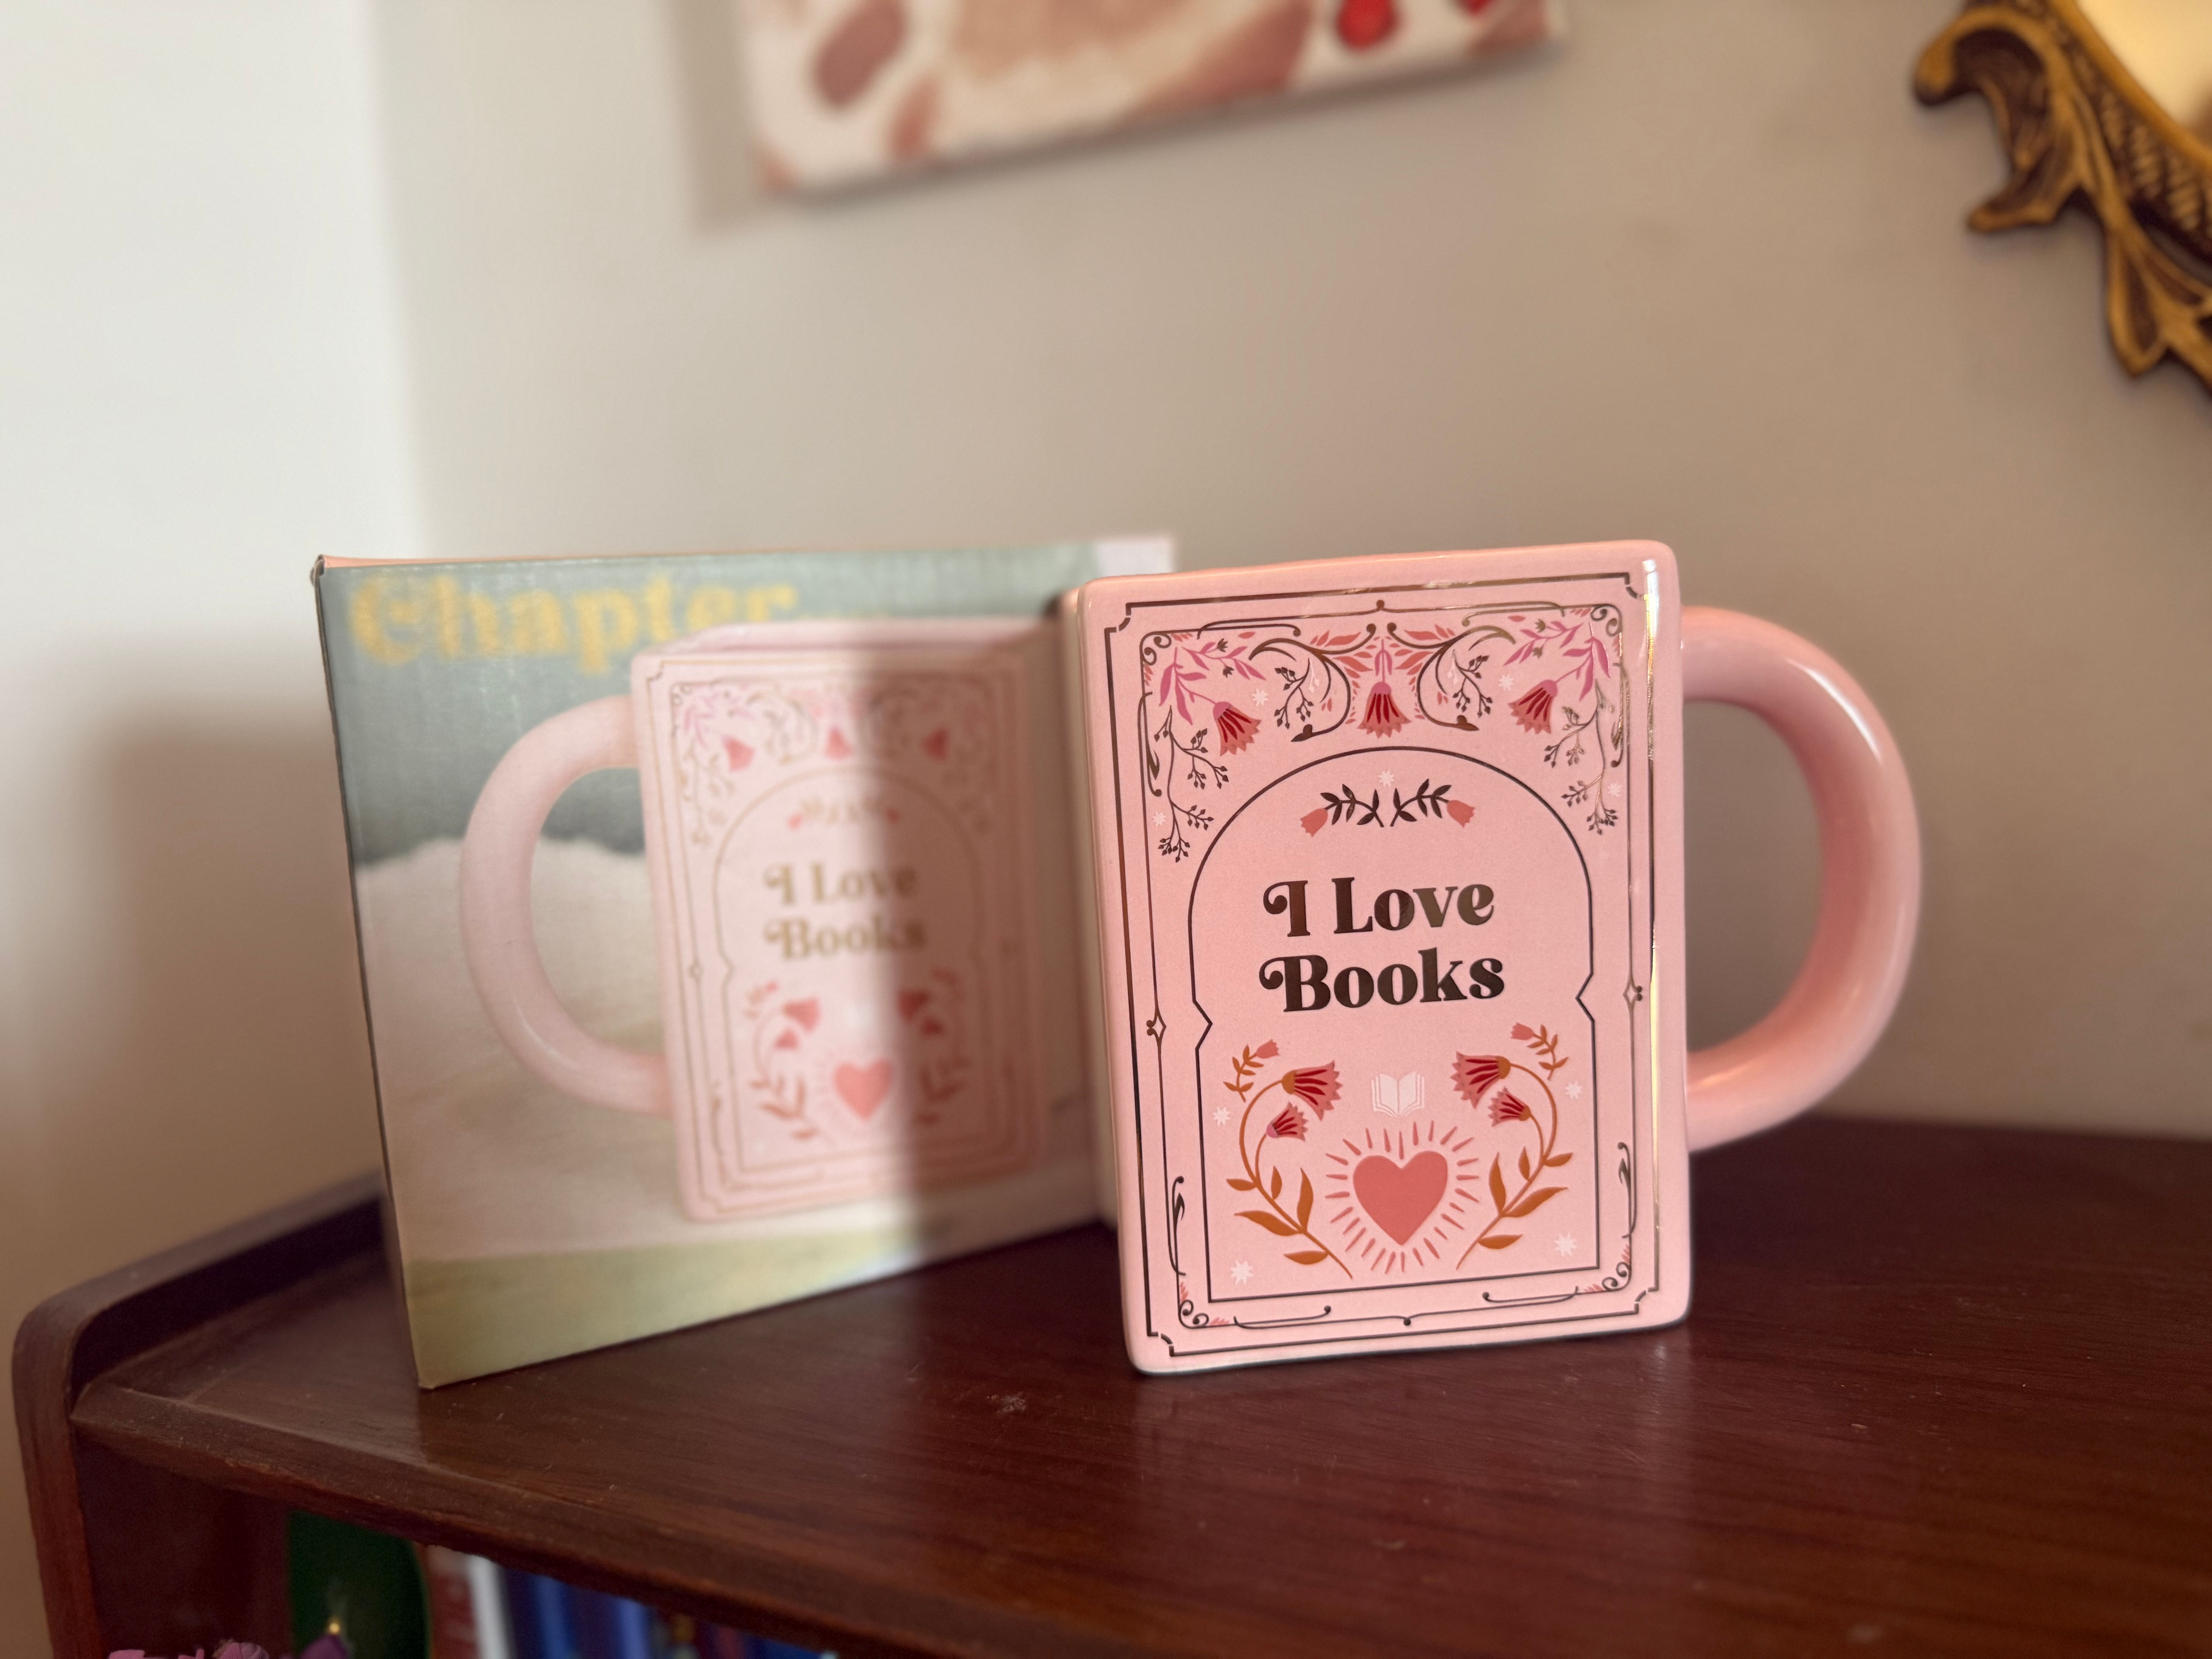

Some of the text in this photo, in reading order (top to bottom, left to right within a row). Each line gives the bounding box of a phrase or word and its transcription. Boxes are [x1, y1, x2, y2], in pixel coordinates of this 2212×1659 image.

[763, 861, 917, 905] I Love
[1262, 876, 1494, 938] I Love
[763, 912, 927, 960] Books
[1258, 946, 1505, 1012] Books
